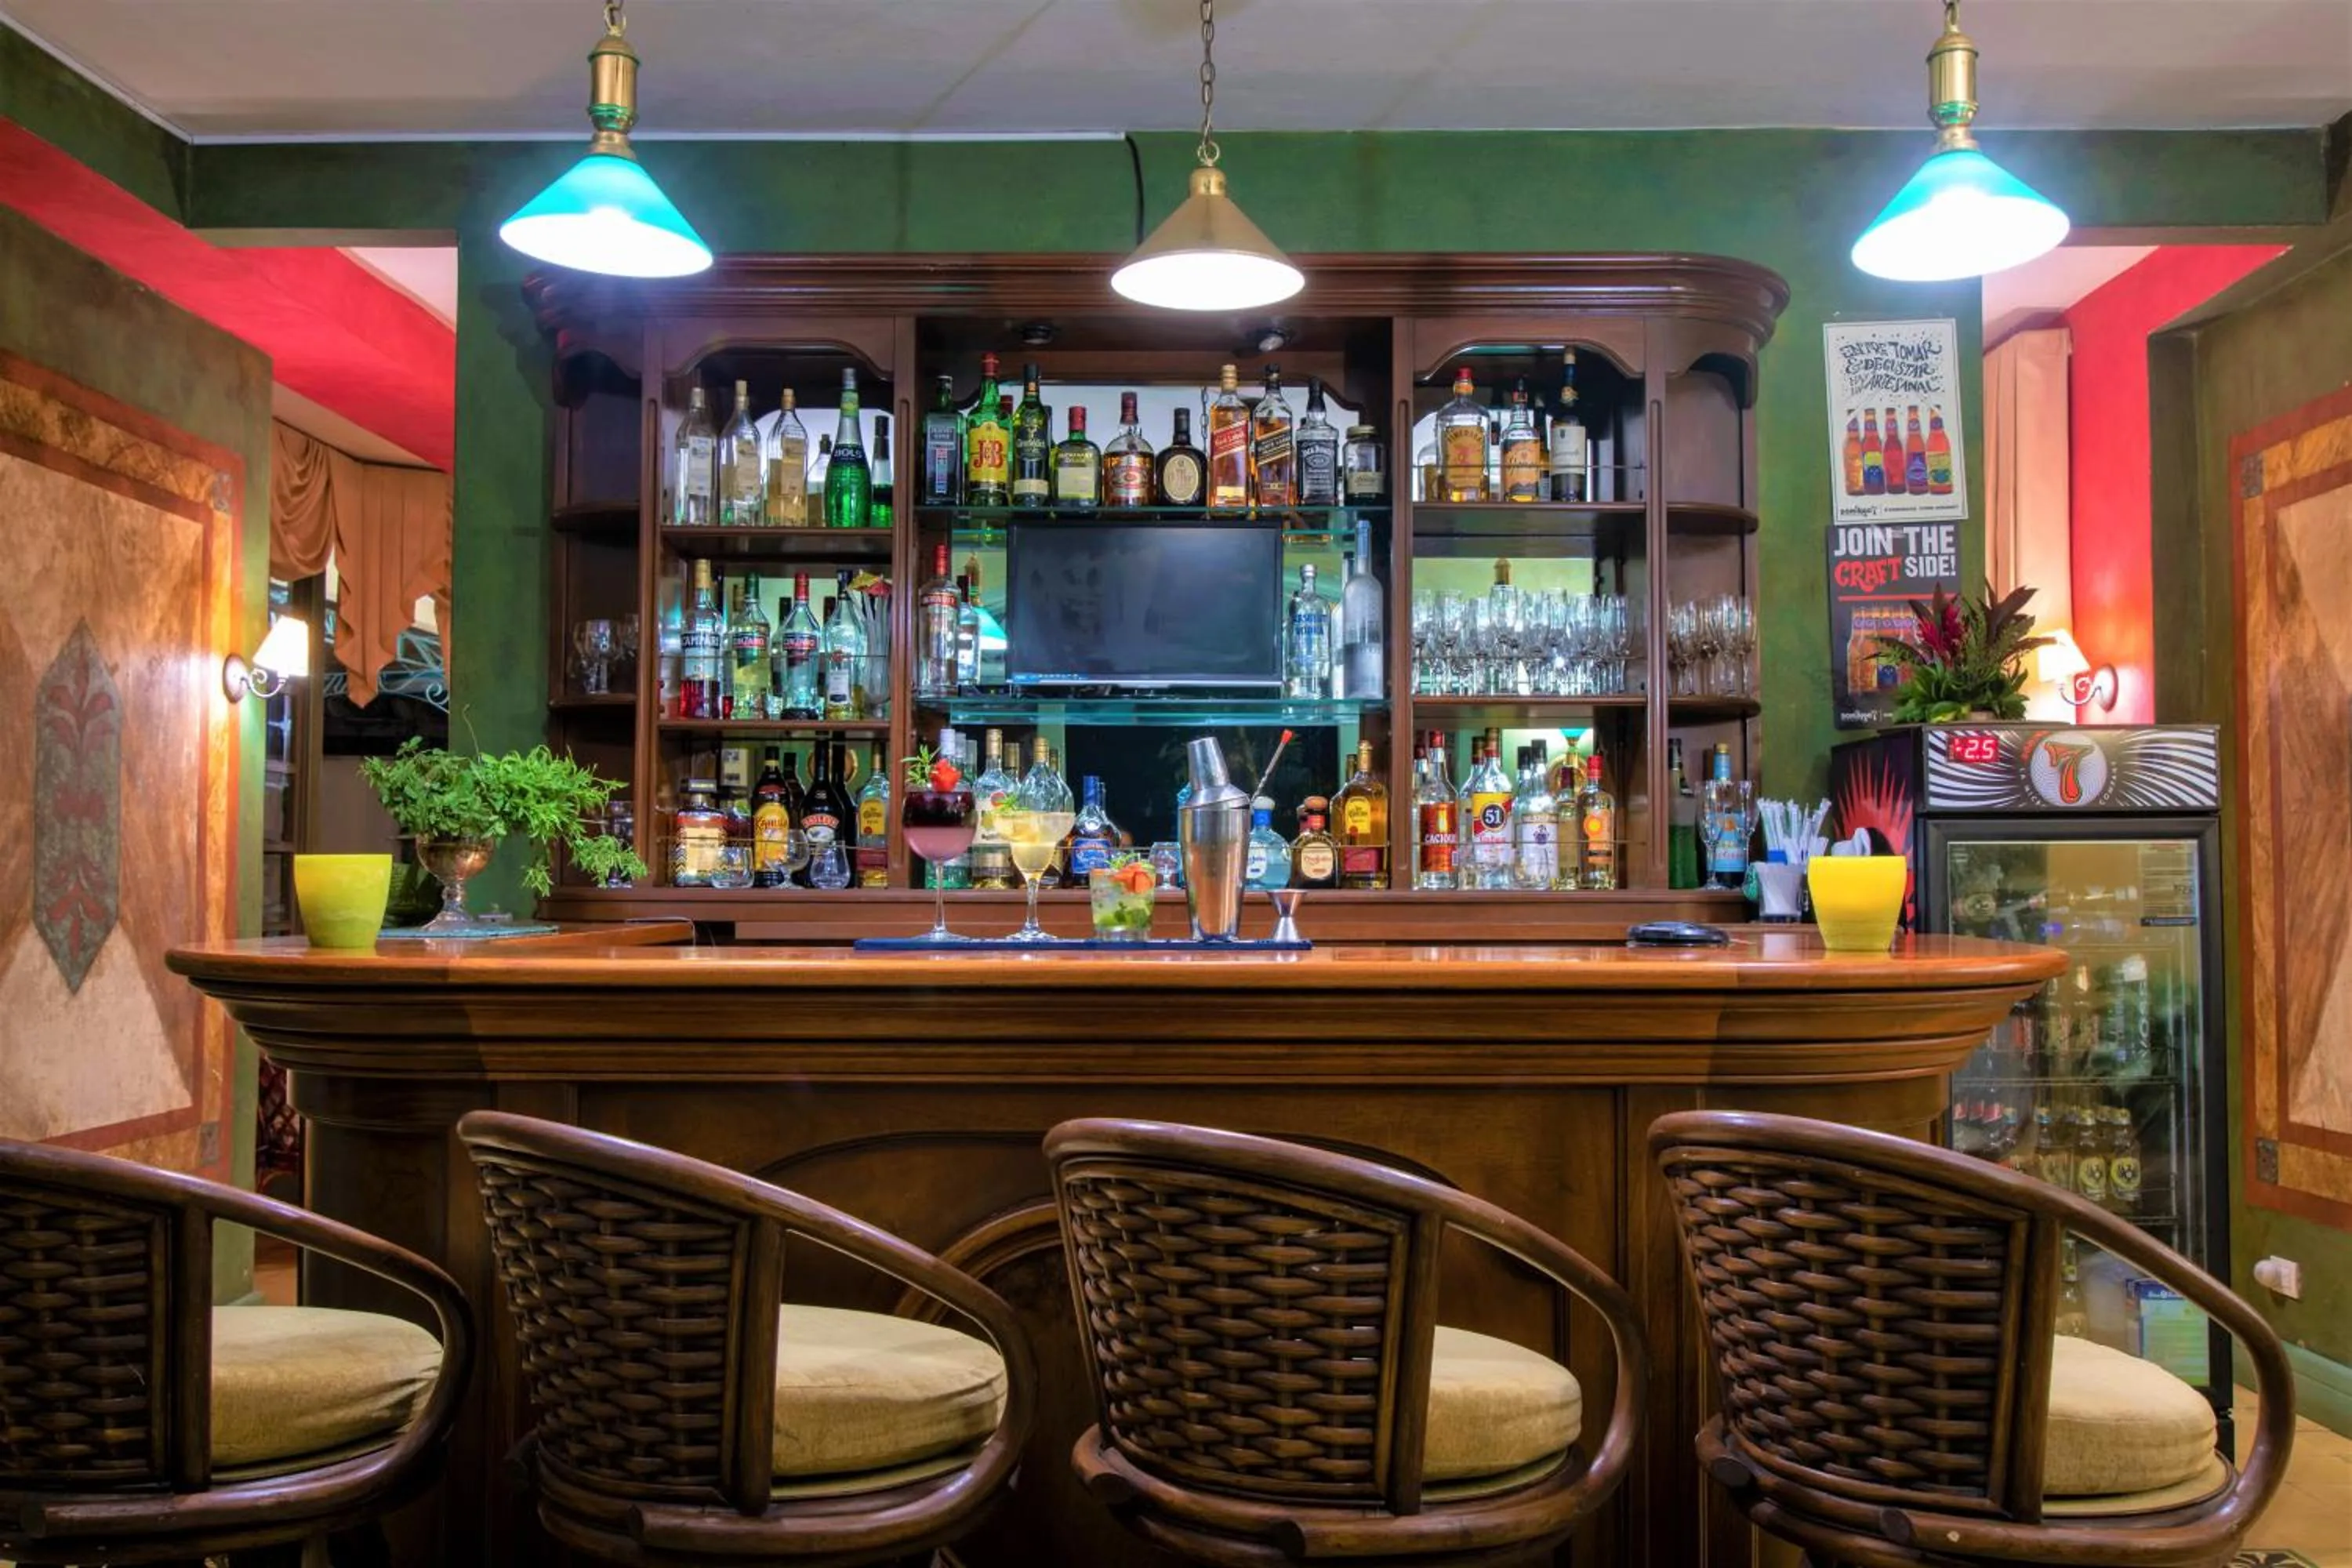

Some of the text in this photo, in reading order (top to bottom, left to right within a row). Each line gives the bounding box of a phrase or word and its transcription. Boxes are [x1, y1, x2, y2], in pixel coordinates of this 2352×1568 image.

[1888, 339, 1942, 361] TOMAR
[1864, 358, 1936, 378] DEGUSTAR
[1834, 524, 1955, 556] JOIN THE
[1835, 555, 1956, 592] CRAFT SIDE!
[802, 815, 840, 828] BAILEYS
[1484, 809, 1501, 825] 51
